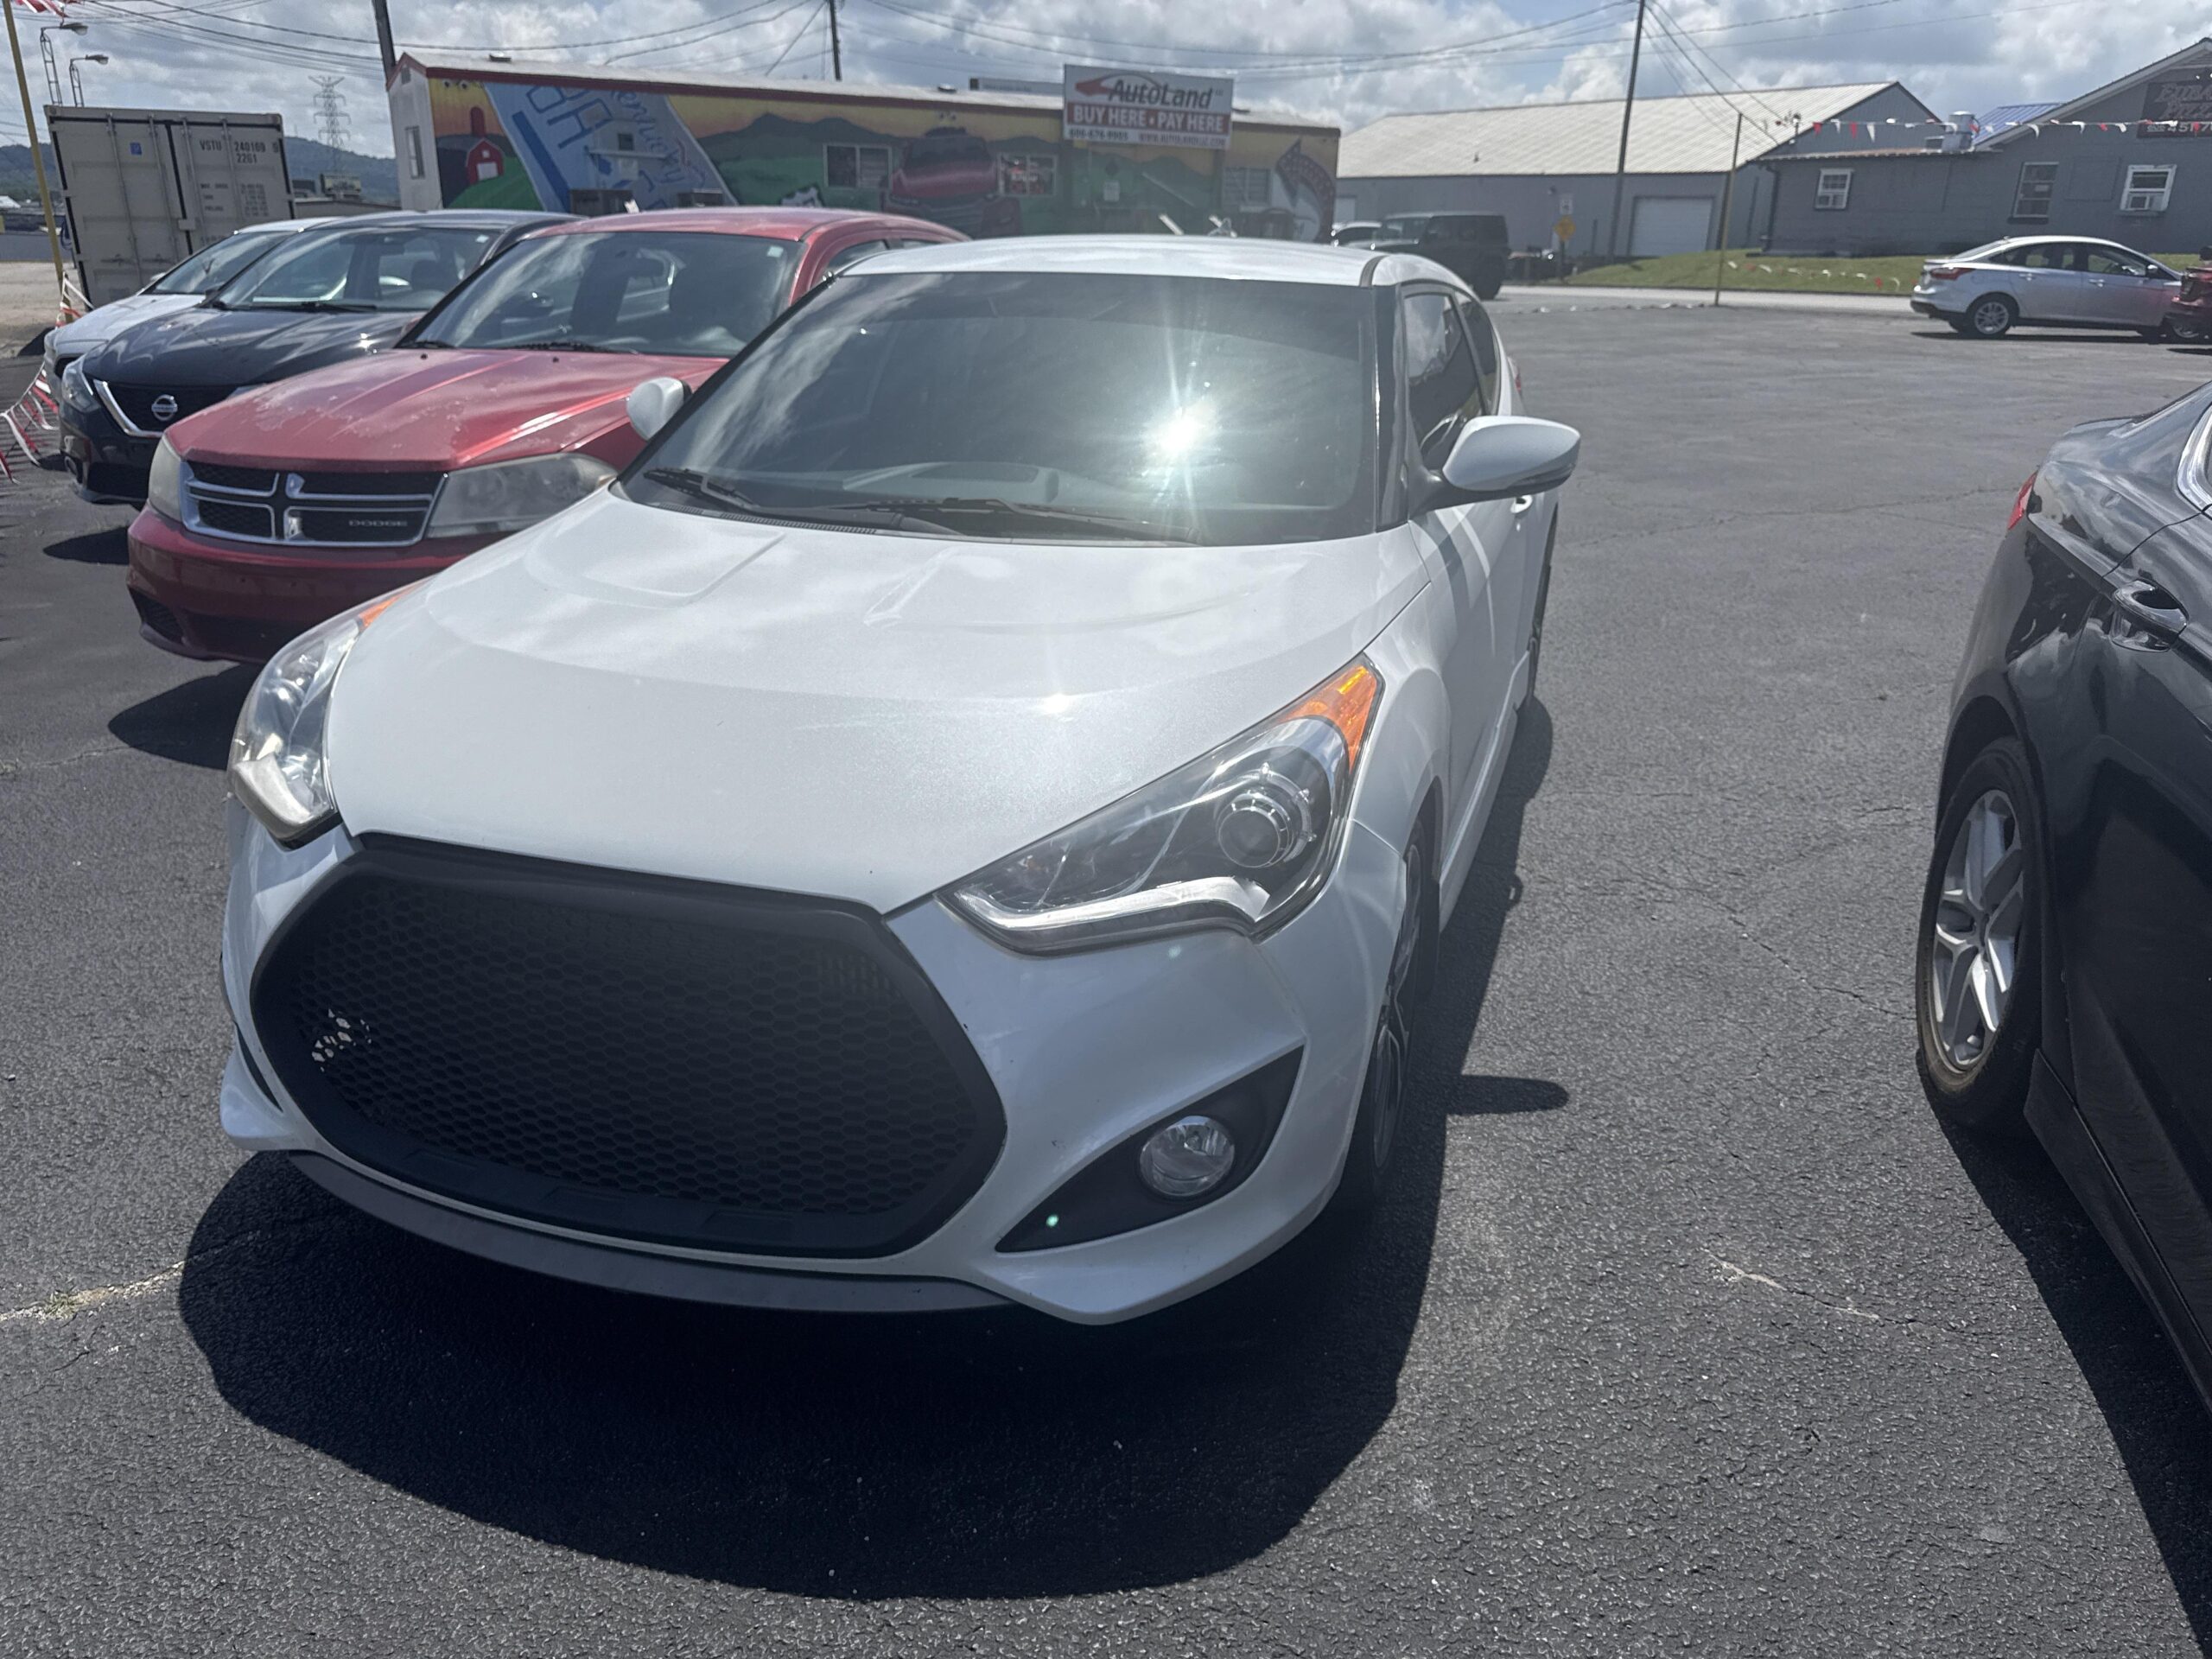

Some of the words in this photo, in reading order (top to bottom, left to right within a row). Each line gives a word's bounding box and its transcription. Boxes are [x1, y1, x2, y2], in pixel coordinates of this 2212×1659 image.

[1109, 79, 1213, 110] AutoLand
[1073, 105, 1107, 124] BUY
[1109, 107, 1147, 127] HERE
[1157, 112, 1186, 130] PAY
[1186, 114, 1223, 131] HERE
[200, 140, 222, 151] VSTU
